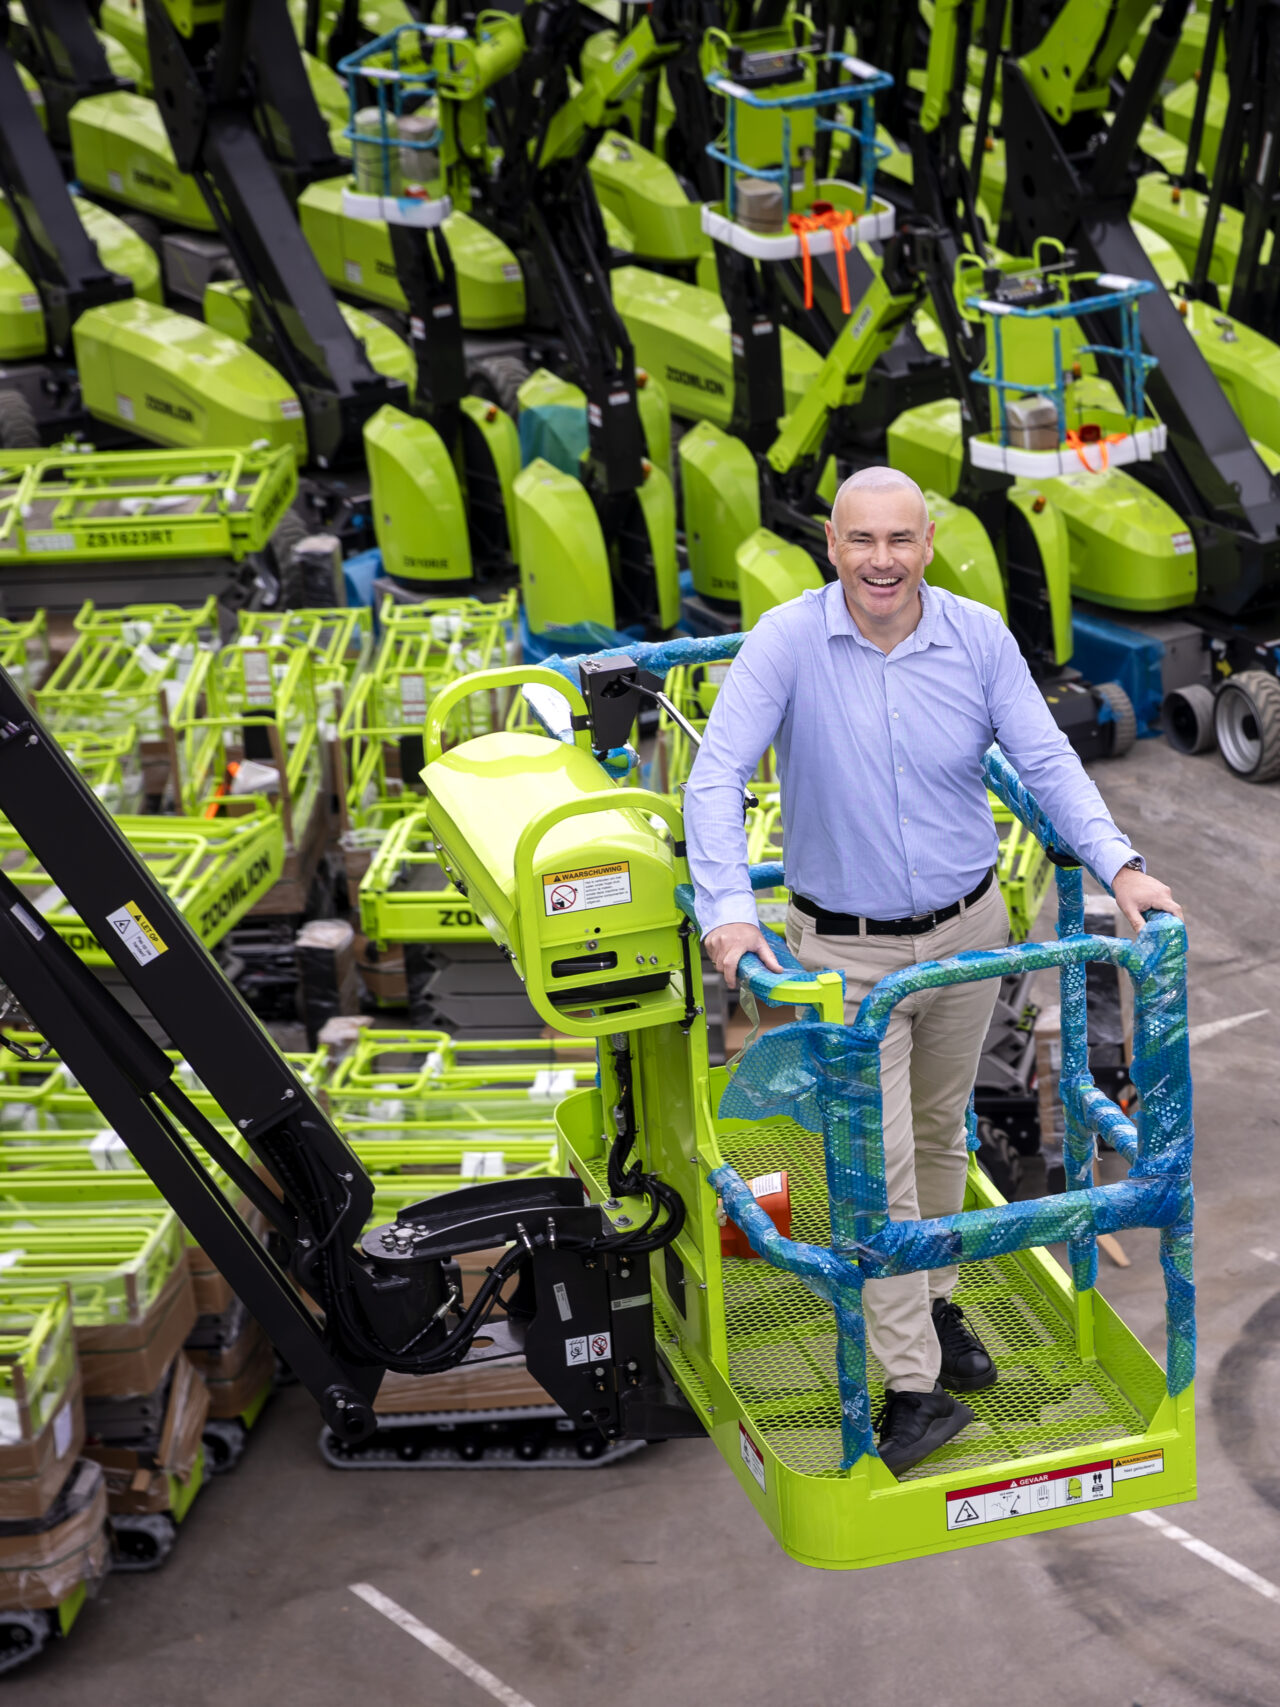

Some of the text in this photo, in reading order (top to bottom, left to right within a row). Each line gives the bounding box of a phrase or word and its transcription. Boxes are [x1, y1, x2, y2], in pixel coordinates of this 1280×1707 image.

[665, 364, 726, 397] ZOOMLION
[86, 529, 174, 548] ZS1623RT
[562, 865, 622, 881] WAARSCHUWING
[199, 850, 271, 938] ZOOMLION
[140, 921, 159, 942] LET OP
[1019, 1474, 1049, 1486] GEVAAR
